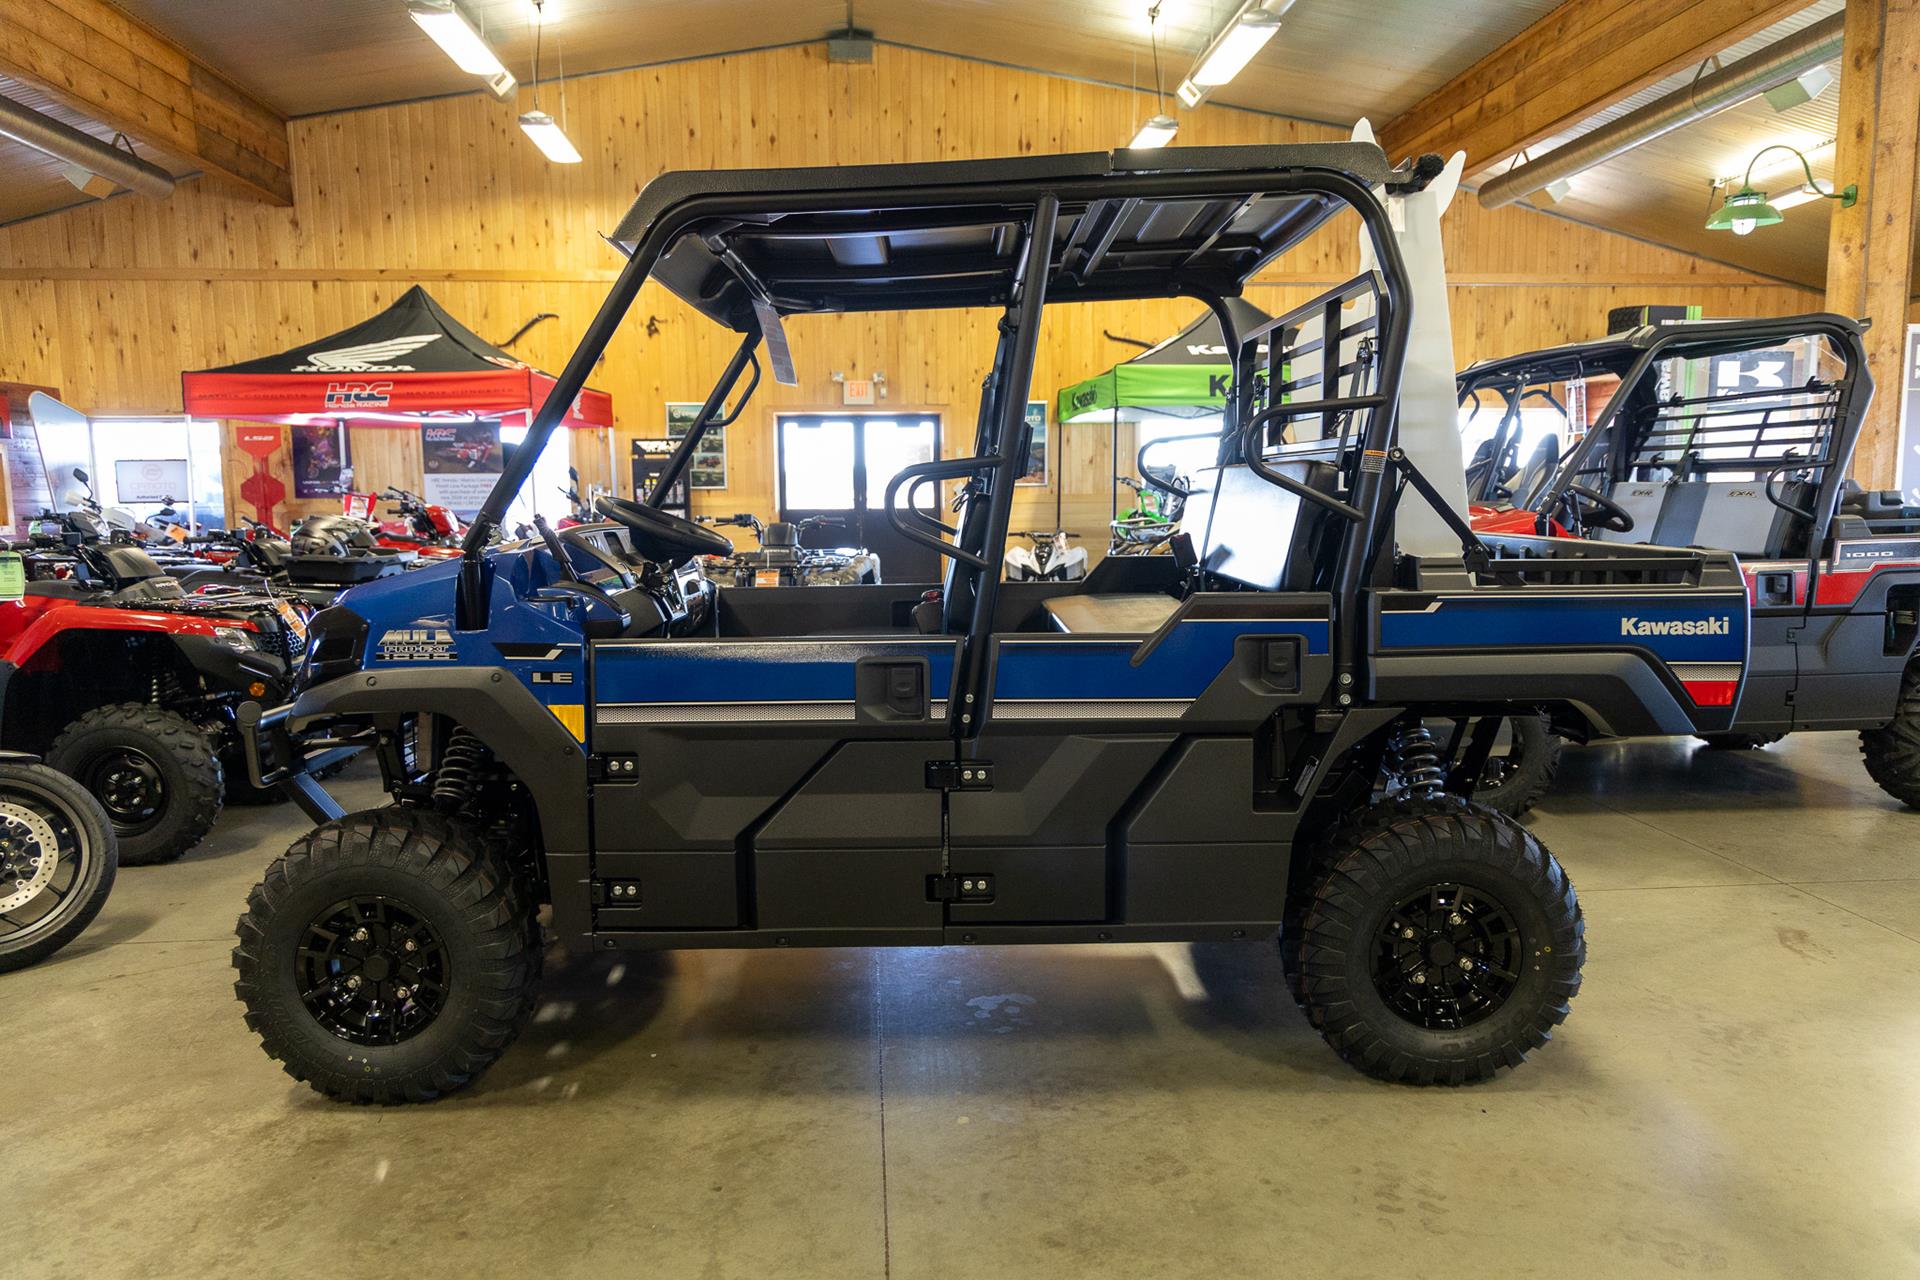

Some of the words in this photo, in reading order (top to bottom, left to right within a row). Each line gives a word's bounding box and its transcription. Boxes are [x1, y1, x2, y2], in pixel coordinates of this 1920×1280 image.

[326, 381, 393, 403] HRC
[849, 382, 868, 398] EXIT
[1621, 616, 1729, 636] Kawasaki
[377, 630, 456, 645] MULE
[532, 672, 573, 684] LE
